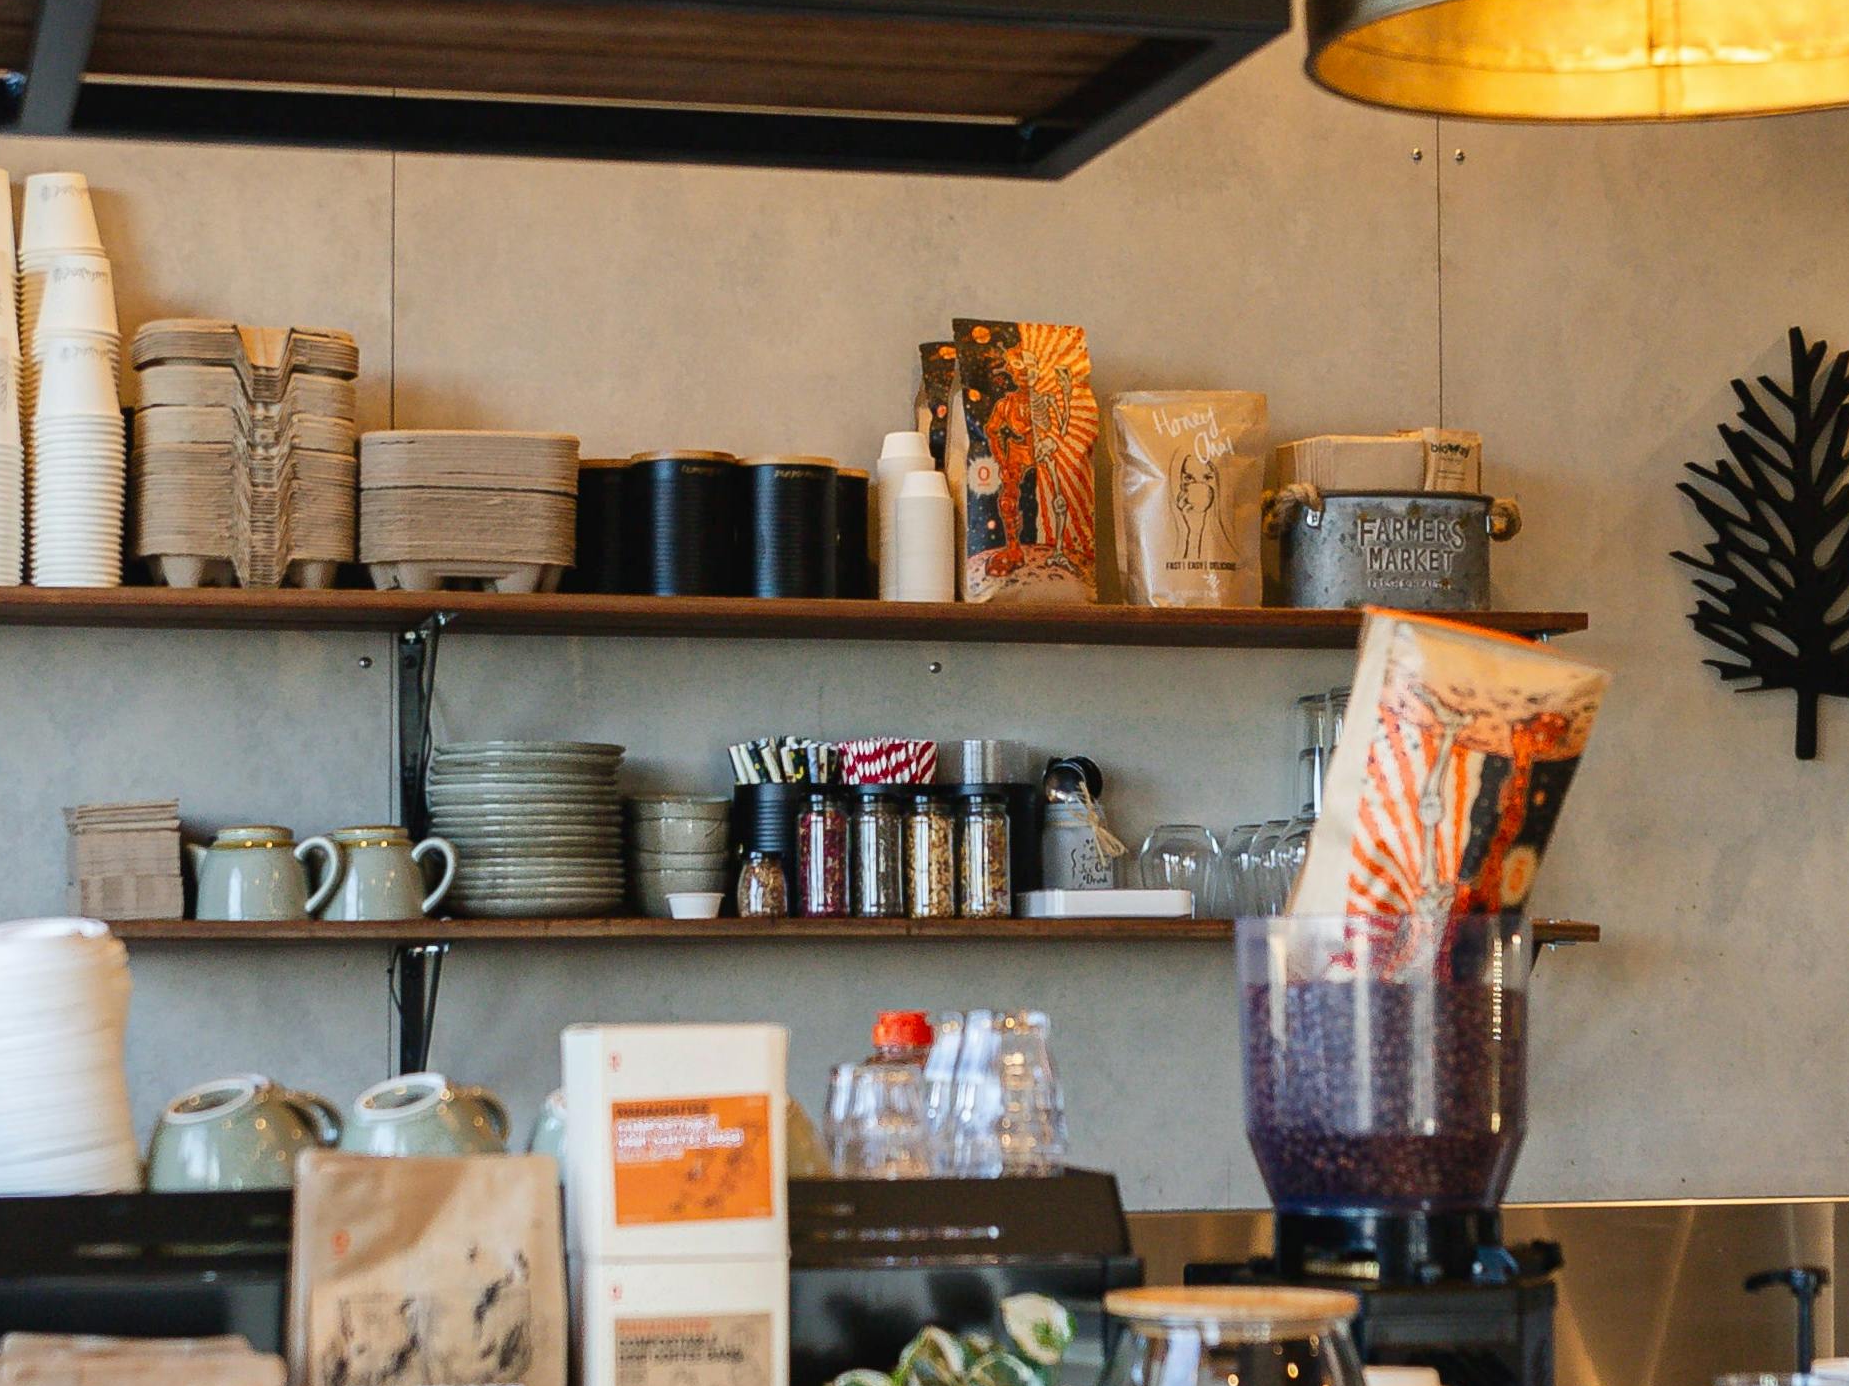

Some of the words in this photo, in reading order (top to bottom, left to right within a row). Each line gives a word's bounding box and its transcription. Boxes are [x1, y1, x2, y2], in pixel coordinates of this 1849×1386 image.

[1152, 407, 1218, 437] Honey
[1357, 515, 1466, 551] FARMERS
[1366, 547, 1456, 575] MARKET
